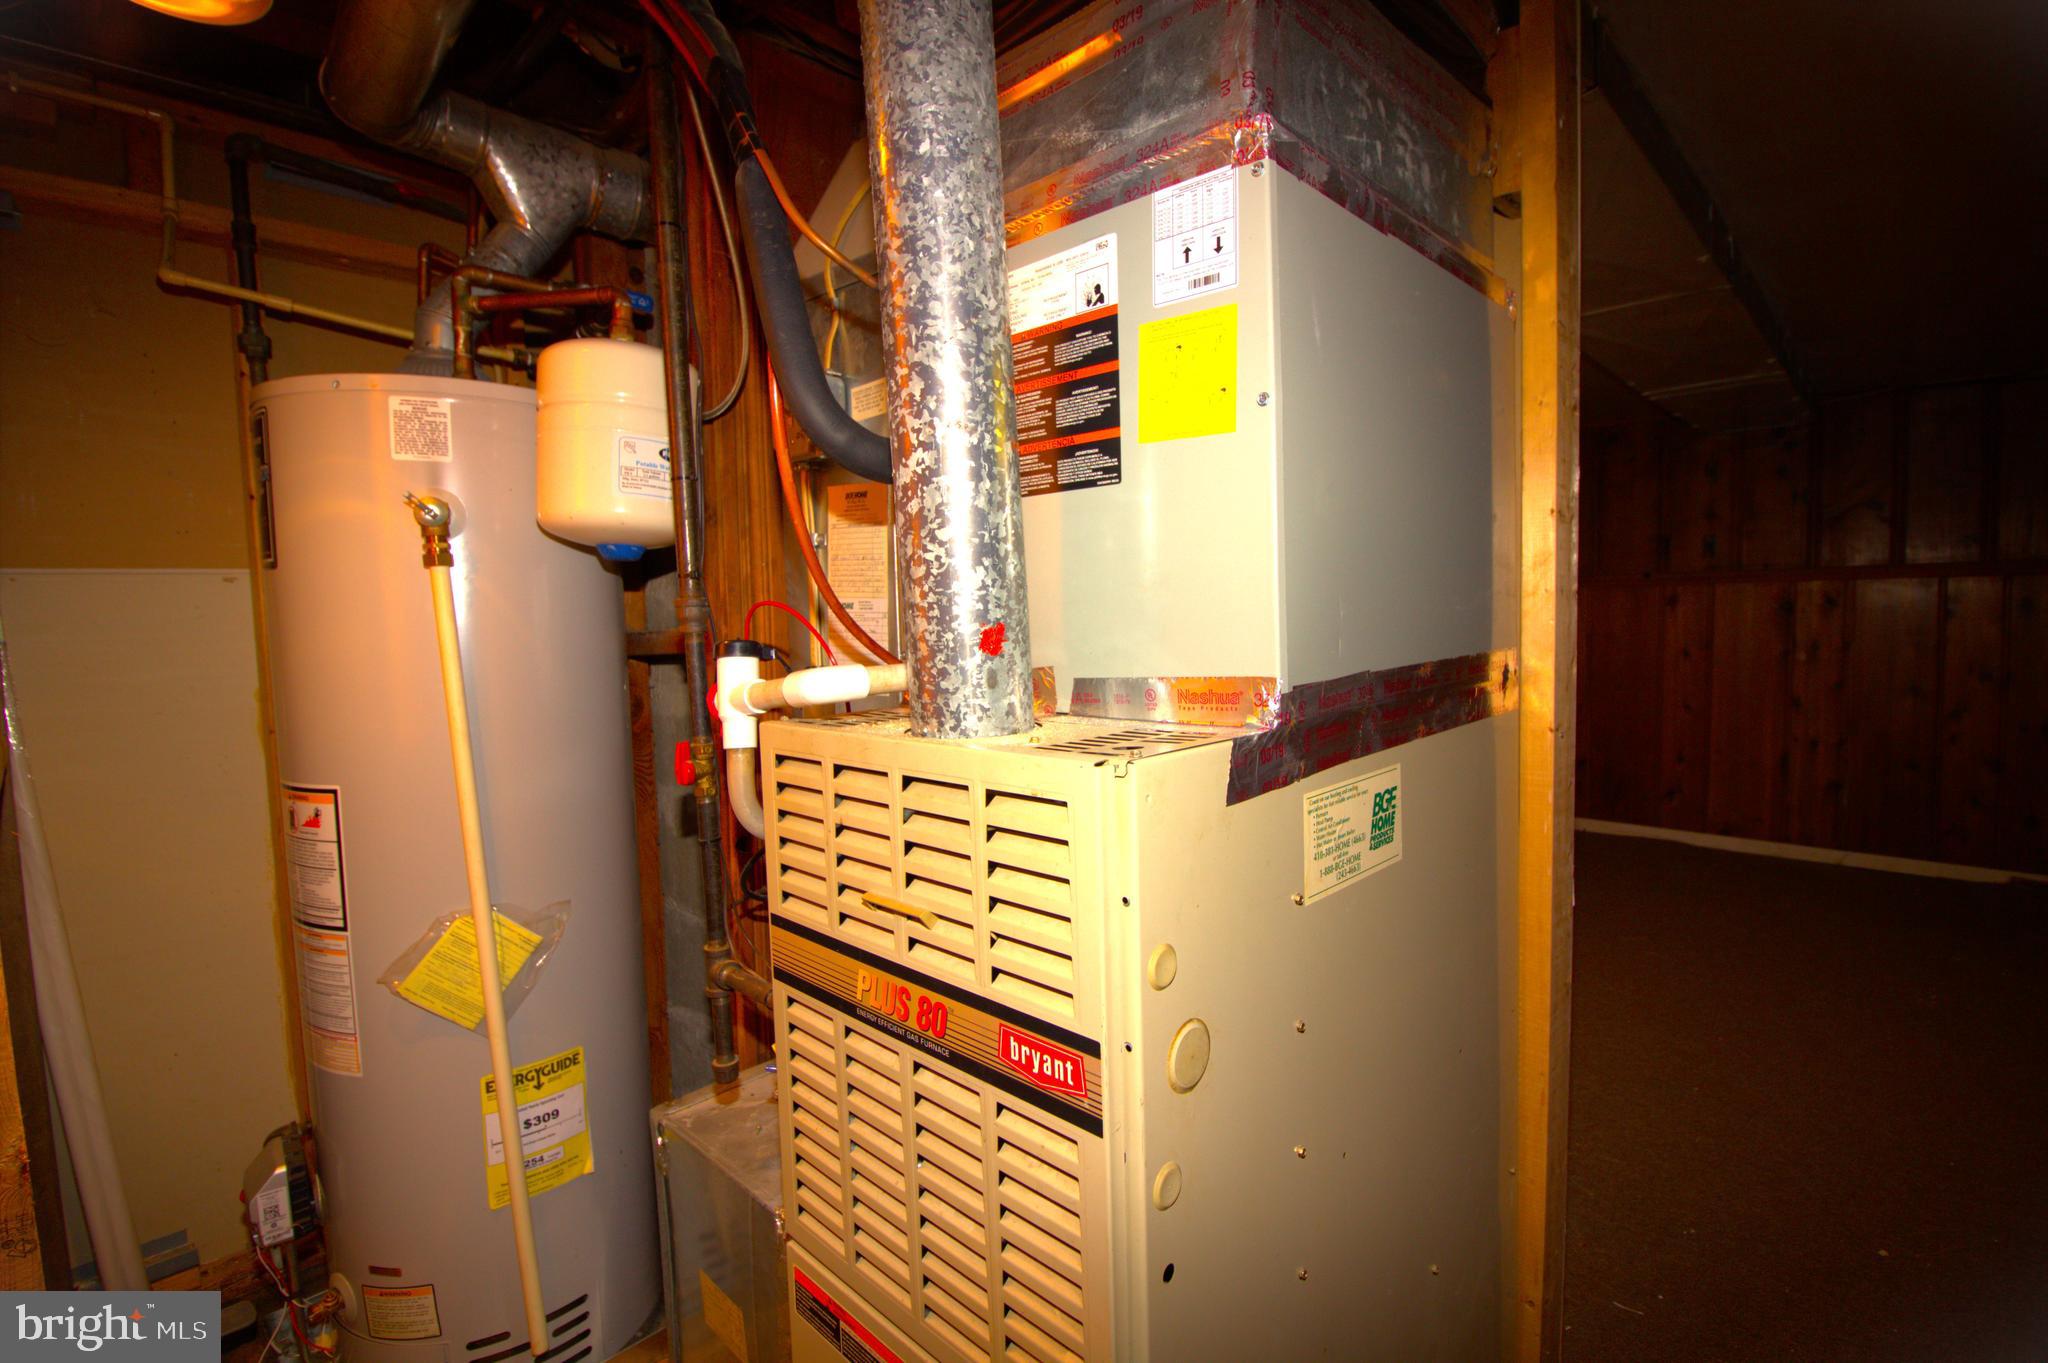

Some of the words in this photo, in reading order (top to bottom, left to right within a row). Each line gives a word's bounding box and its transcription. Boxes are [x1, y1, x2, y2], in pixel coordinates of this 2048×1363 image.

[1372, 786, 1398, 817] BGE
[1371, 810, 1395, 835] HOME
[857, 968, 911, 1022] PLUS
[856, 1007, 878, 1023] ENERGY
[878, 1014, 906, 1037] EFFICIENT
[906, 1029, 920, 1044] GAS
[920, 1037, 950, 1058] FURNACE
[485, 1052, 581, 1094] ERGYGUIDE
[1009, 1036, 1075, 1086] bryant
[523, 1108, 560, 1131] $309
[524, 1154, 545, 1168] 254
